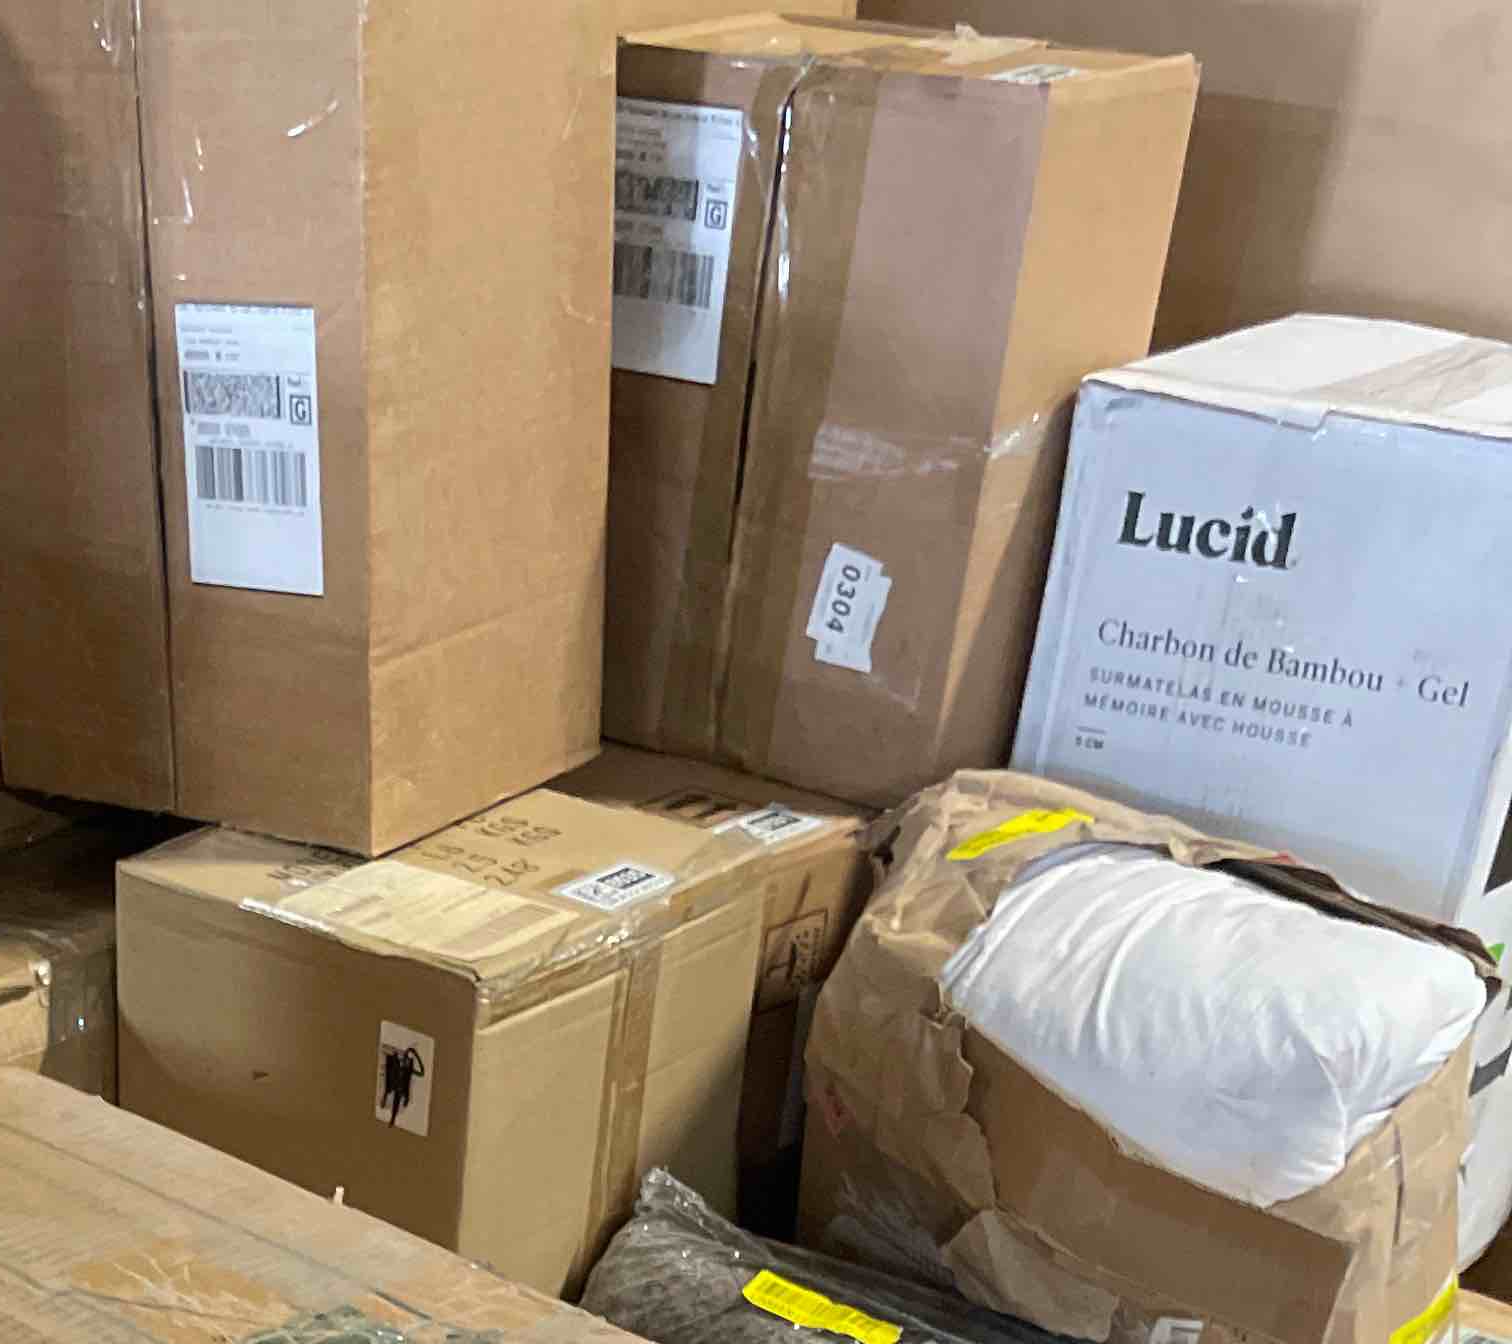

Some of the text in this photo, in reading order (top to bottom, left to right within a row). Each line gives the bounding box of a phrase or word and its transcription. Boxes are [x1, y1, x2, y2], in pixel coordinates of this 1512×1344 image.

[1118, 491, 1298, 569] Lucid
[826, 564, 861, 634] 0304
[1090, 667, 1211, 702] SURMATELAS
[1220, 690, 1246, 710] EN
[1253, 695, 1333, 726] MOUSSE
[1098, 618, 1215, 663] Charbon
[1224, 641, 1258, 669] de
[1267, 647, 1383, 693] Bambou
[1418, 675, 1469, 707] Gel
[1177, 711, 1225, 732] AVEC
[1232, 720, 1312, 749] HOUSSE
